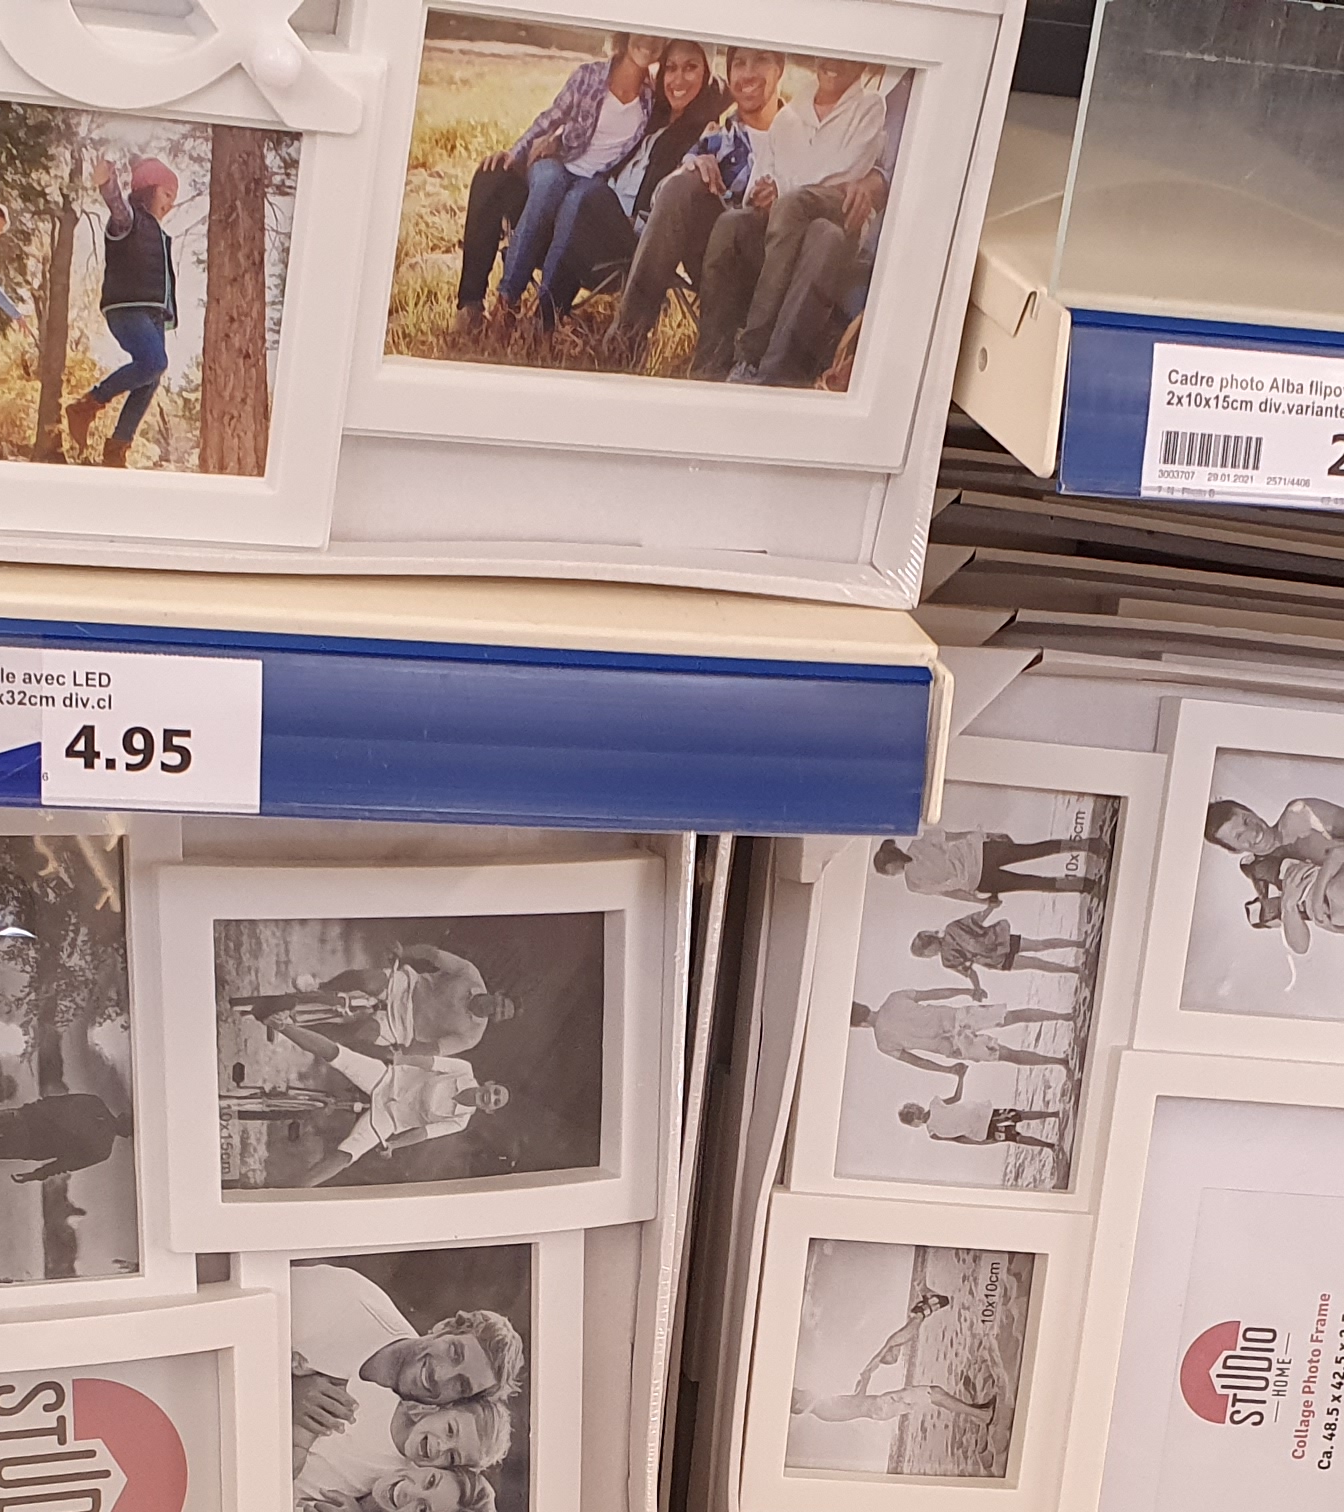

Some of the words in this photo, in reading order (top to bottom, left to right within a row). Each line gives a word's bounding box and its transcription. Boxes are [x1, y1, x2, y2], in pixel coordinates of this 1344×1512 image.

[1166, 391, 1254, 413] 2x10x15cm
[1167, 369, 1215, 388] Cadre
[1219, 374, 1265, 393] photo
[1269, 377, 1304, 395] Alba
[21, 671, 66, 687] avec
[72, 670, 112, 688] LED
[64, 724, 194, 773] 4.95
[1065, 809, 1085, 880] 10x5cm
[980, 1260, 1001, 1325] 10x10cm
[1310, 1292, 1331, 1344] Frame
[1216, 1326, 1278, 1427] STUDIO
[1272, 1357, 1292, 1397] HOME
[1302, 1348, 1322, 1395] Photo
[1331, 1393, 1343, 1404] x
[1291, 1399, 1316, 1460] Collage
[1322, 1407, 1340, 1442] 48.5
[1317, 1444, 1335, 1470] Ca.
